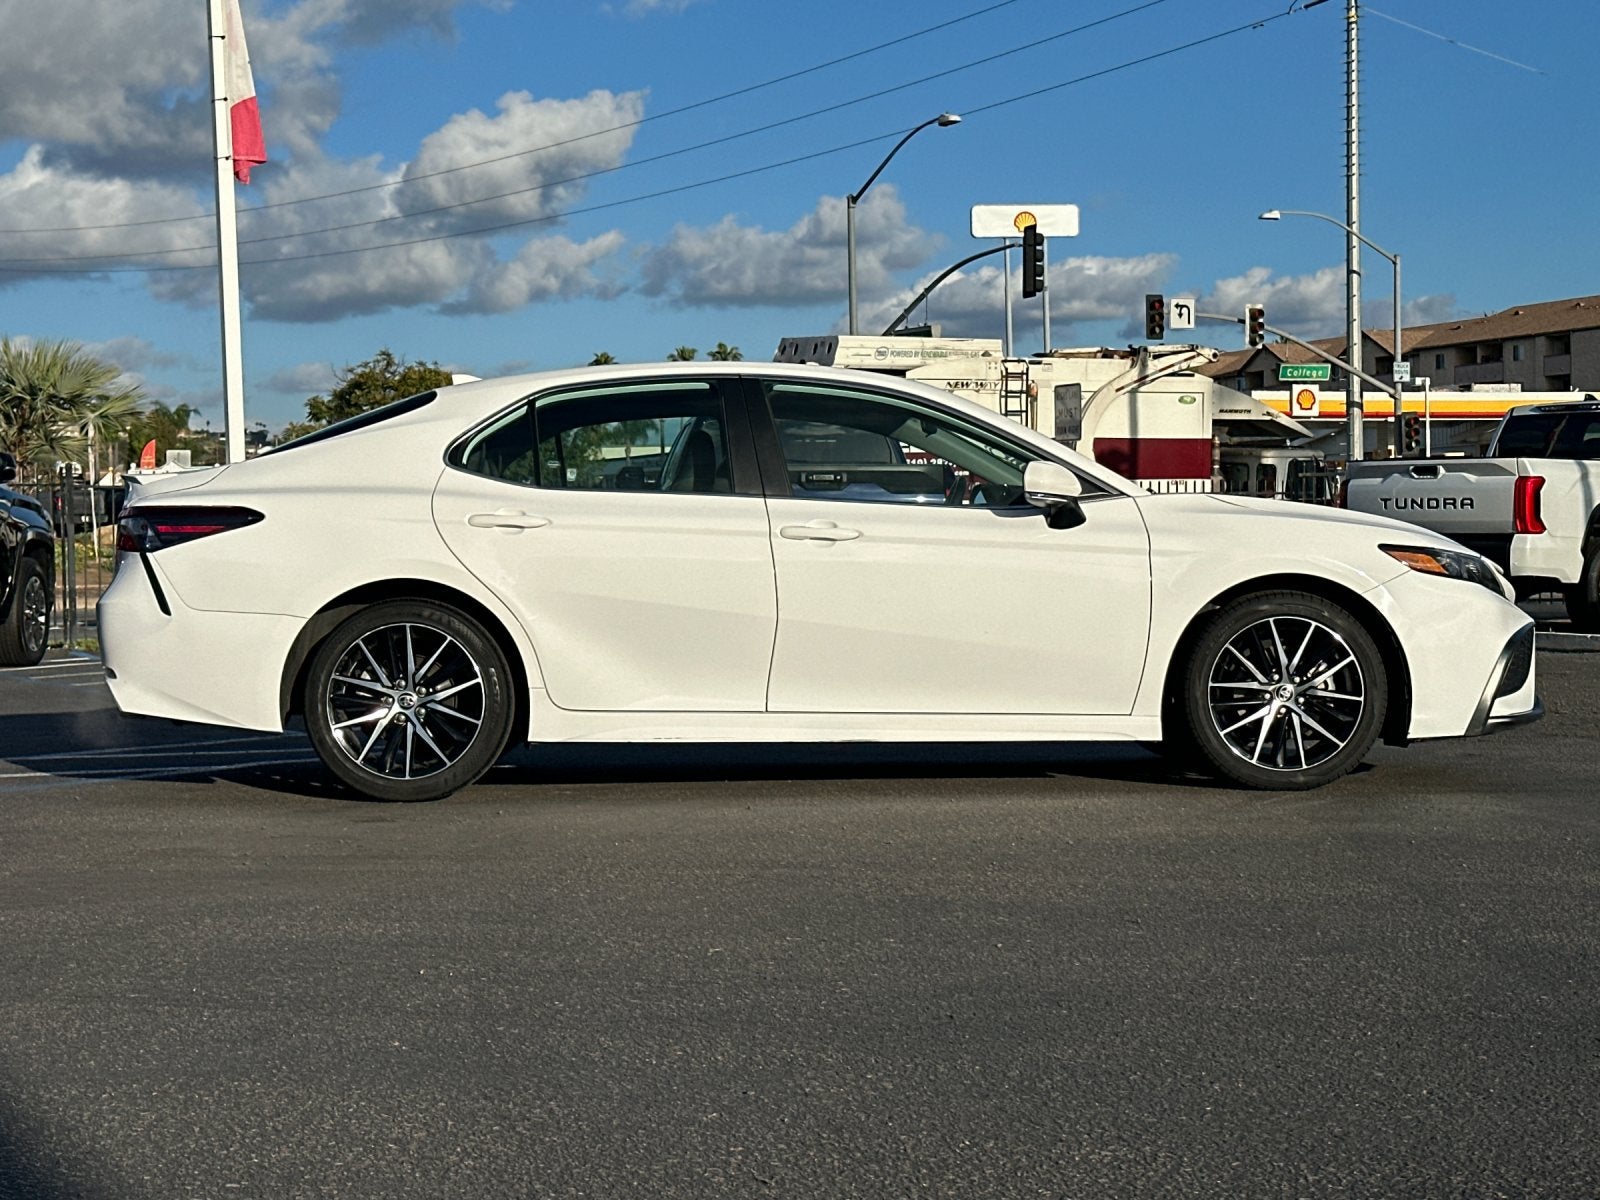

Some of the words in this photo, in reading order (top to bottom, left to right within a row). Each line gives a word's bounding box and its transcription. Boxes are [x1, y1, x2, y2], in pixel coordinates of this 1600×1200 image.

[1286, 368, 1323, 379] College
[945, 381, 971, 389] NEW
[1379, 497, 1475, 510] TUNDRA
